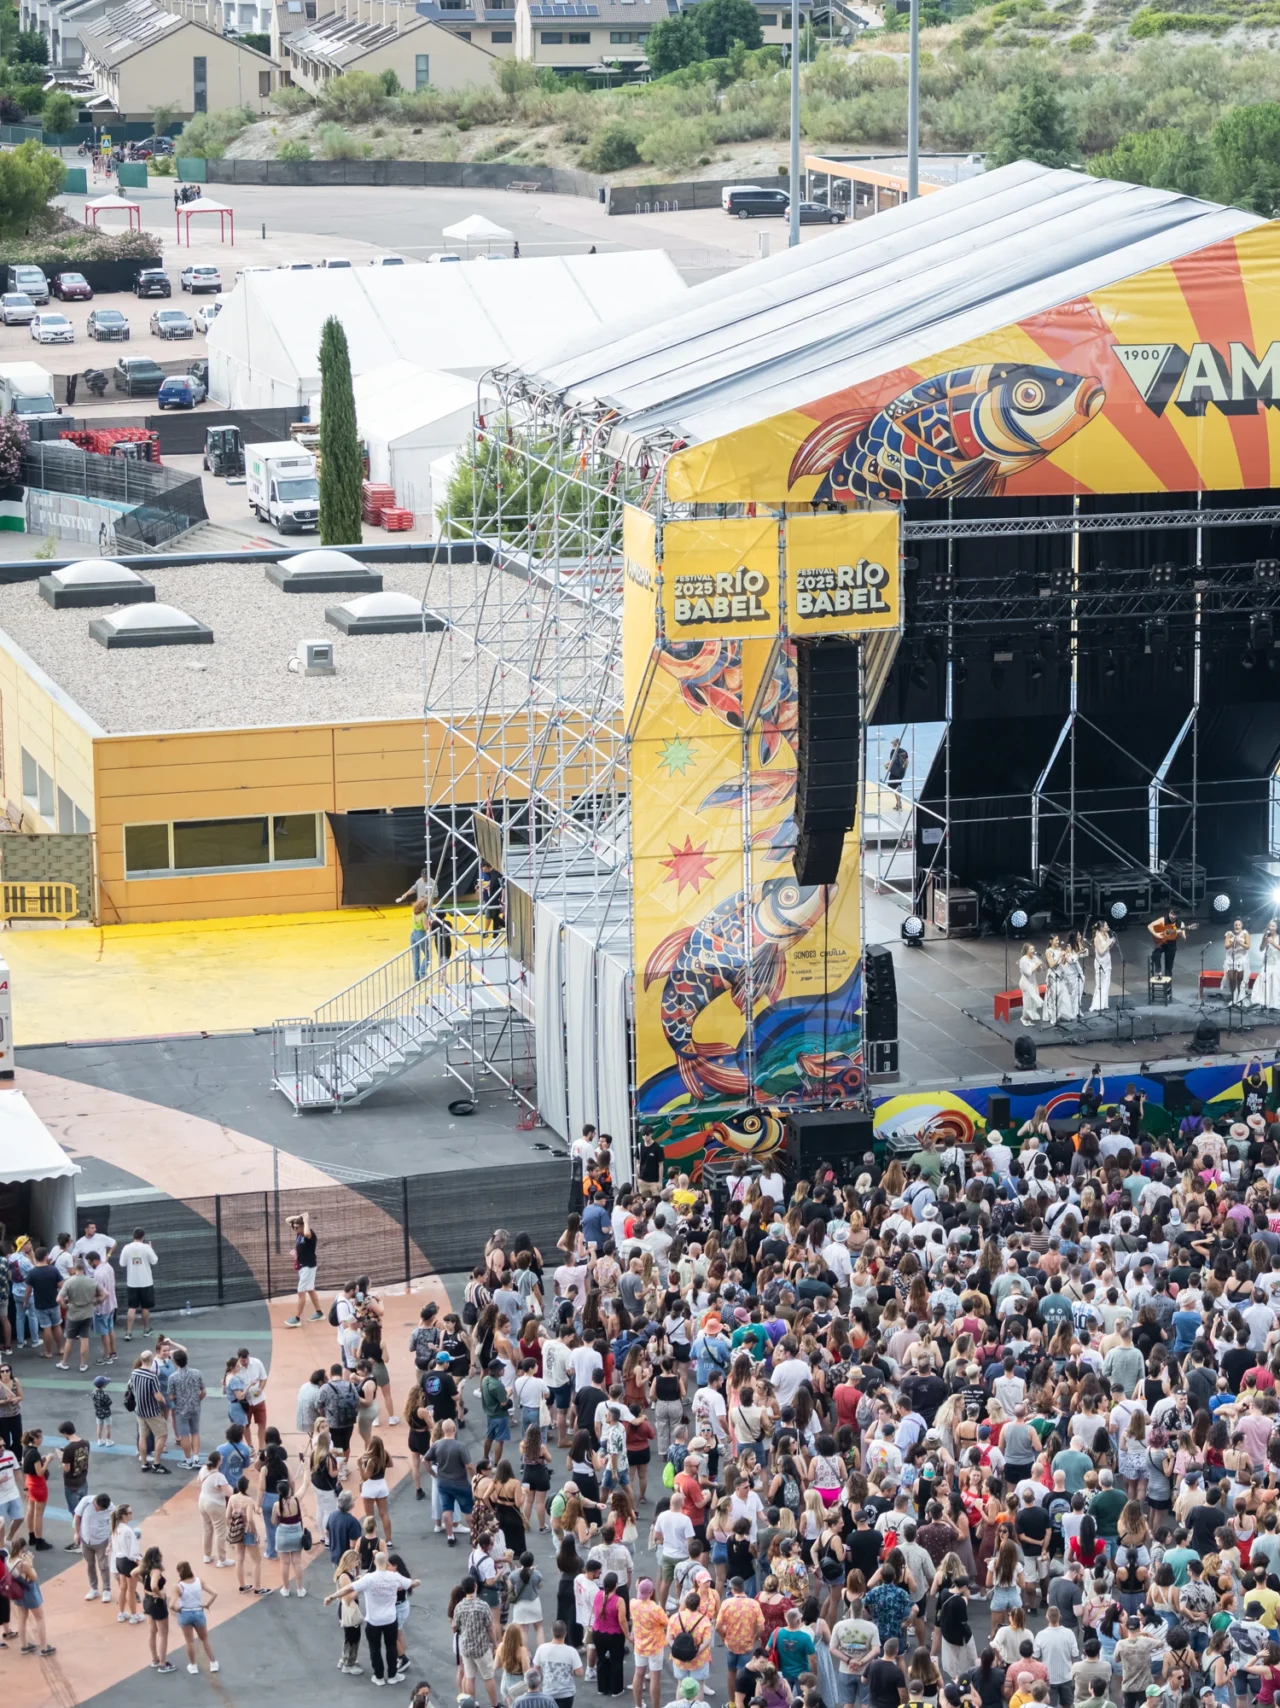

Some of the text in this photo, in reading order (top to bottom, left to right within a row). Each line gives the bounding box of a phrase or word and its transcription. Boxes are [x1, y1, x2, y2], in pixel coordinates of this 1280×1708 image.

[1123, 348, 1161, 362] 1900
[674, 574, 714, 582] FESTIVAL
[674, 564, 767, 596] 2025 RÍO
[796, 567, 835, 576] FESTIVAL
[796, 557, 887, 590] 2025 RÍO
[674, 595, 768, 623] BABEL
[796, 587, 888, 616] BABEL
[1074, 1312, 1088, 1329] 10
